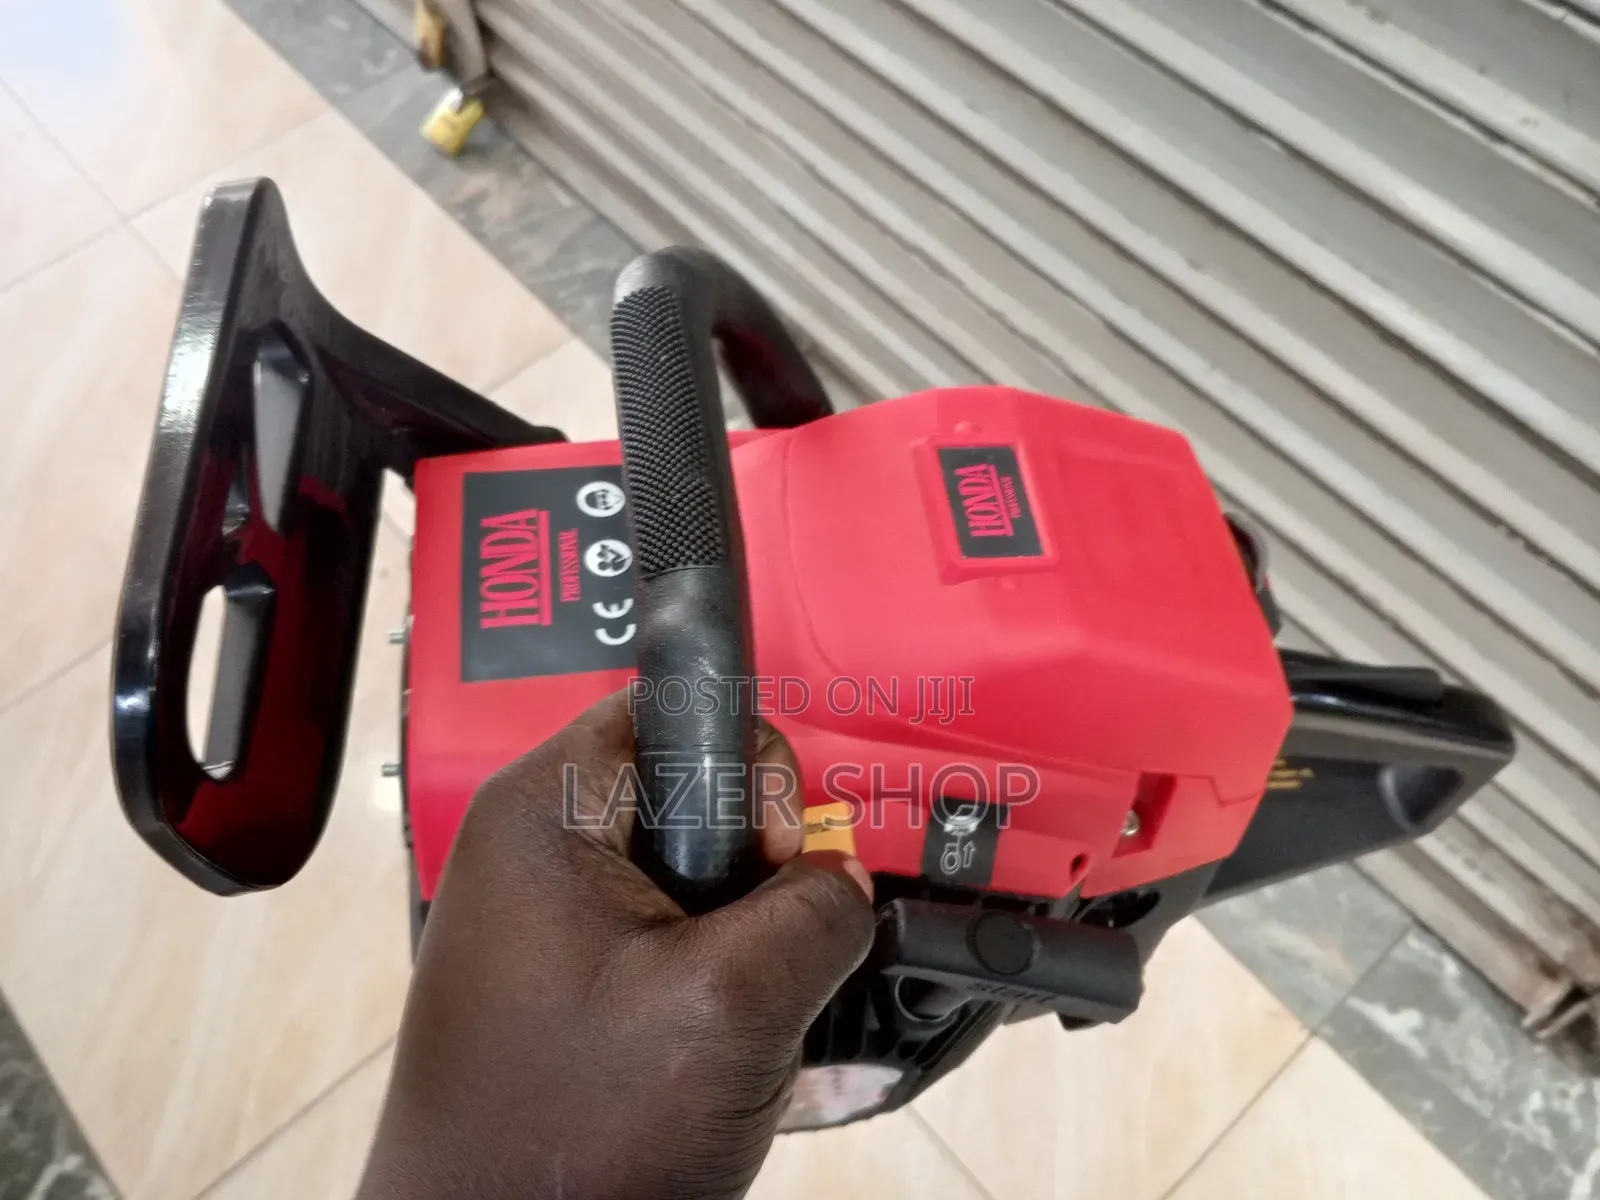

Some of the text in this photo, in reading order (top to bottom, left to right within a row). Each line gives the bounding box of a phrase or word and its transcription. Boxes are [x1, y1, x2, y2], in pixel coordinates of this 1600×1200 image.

[954, 463, 1005, 537] HONDA
[479, 508, 540, 629] HONDA
[592, 598, 637, 646] CE
